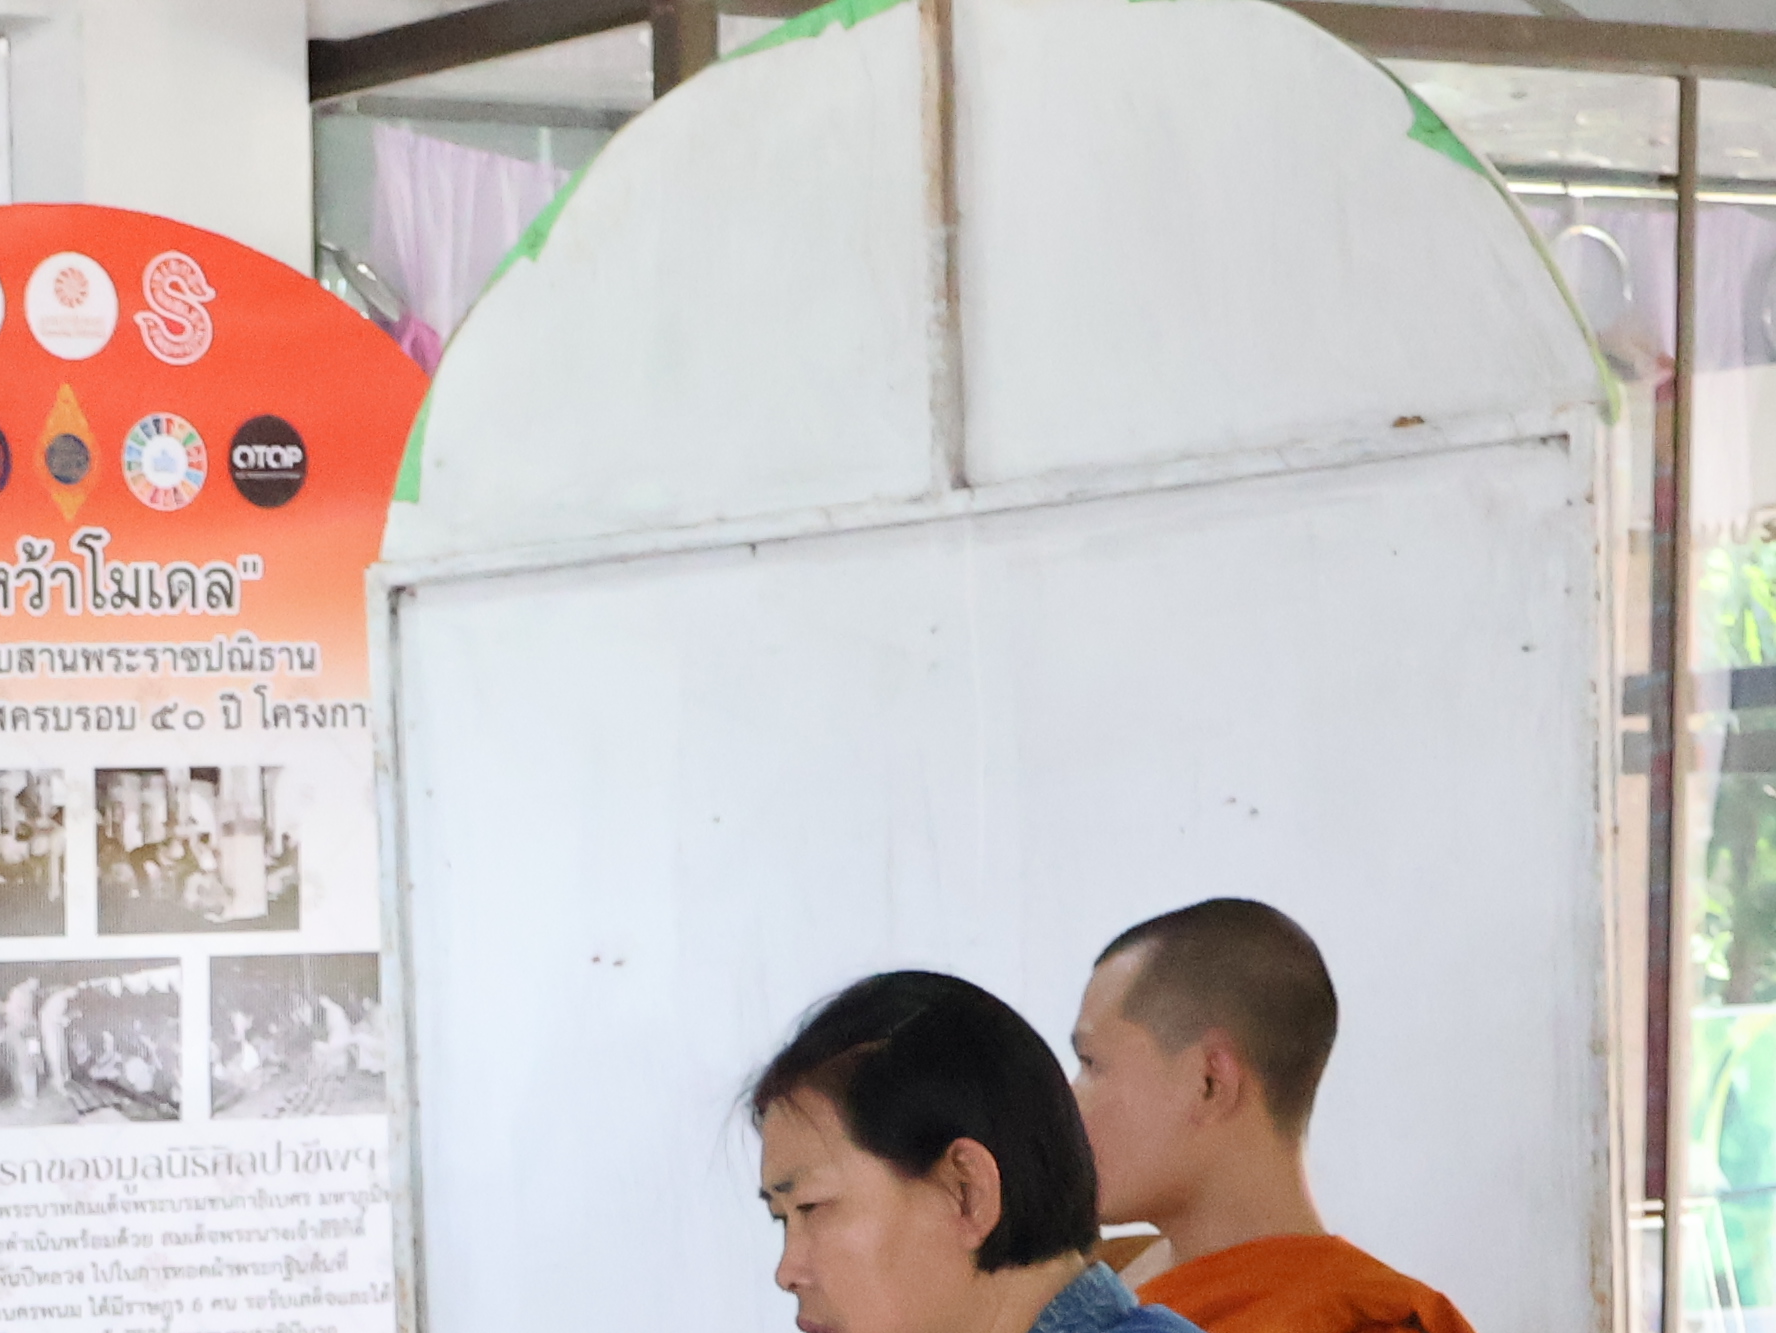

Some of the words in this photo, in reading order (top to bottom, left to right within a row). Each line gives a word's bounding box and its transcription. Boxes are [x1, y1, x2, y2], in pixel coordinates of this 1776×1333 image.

[233, 444, 305, 471] OTOP
[151, 702, 206, 732] ๕๐
[220, 691, 243, 730] ปี
[252, 684, 374, 732] โครงกา
